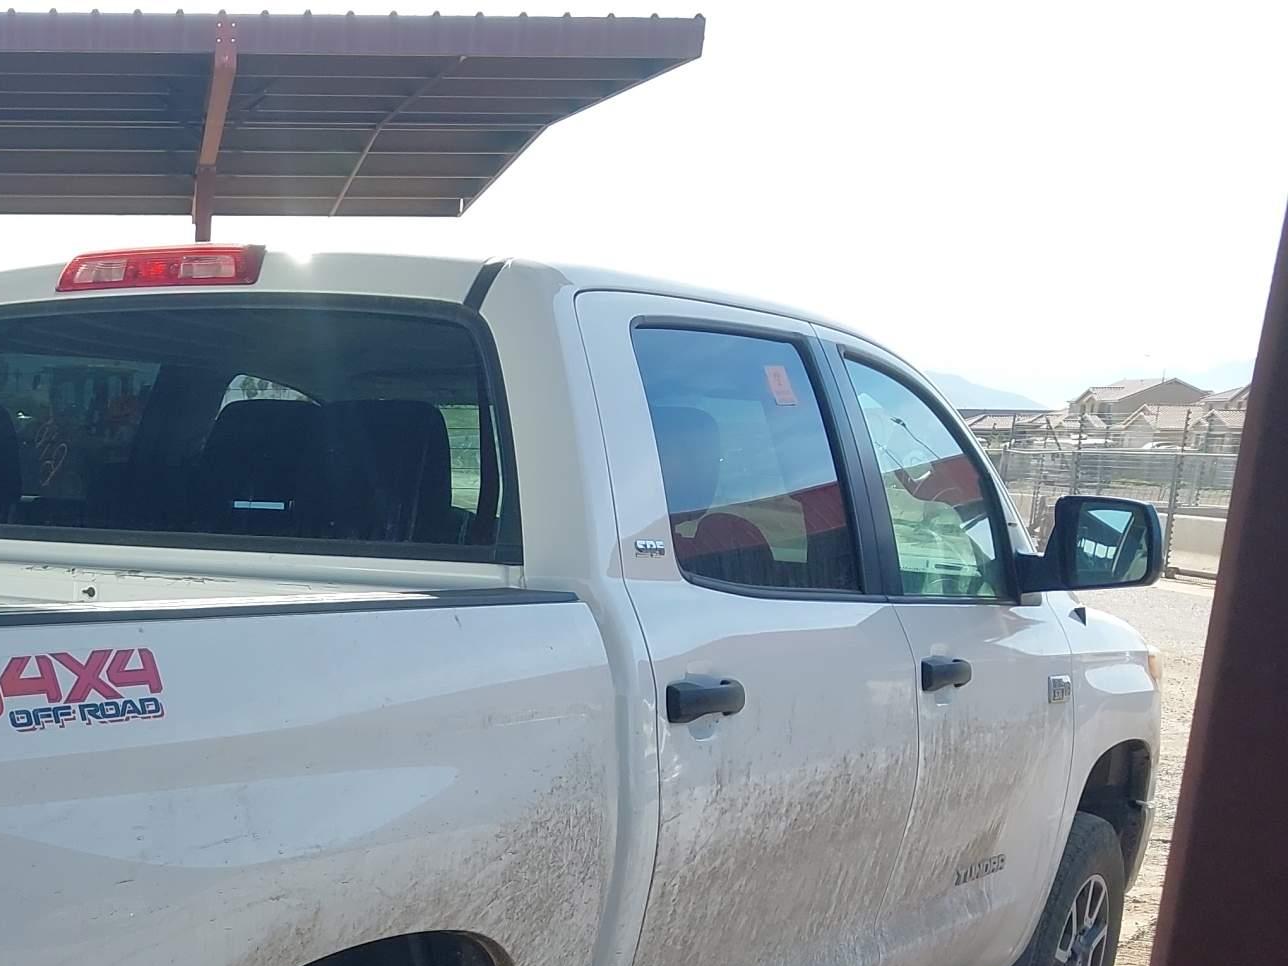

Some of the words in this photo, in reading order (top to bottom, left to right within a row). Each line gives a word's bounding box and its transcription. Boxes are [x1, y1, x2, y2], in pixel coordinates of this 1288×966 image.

[0, 647, 165, 704] 4X4
[9, 704, 77, 733] OFF
[78, 697, 165, 725] ROAD
